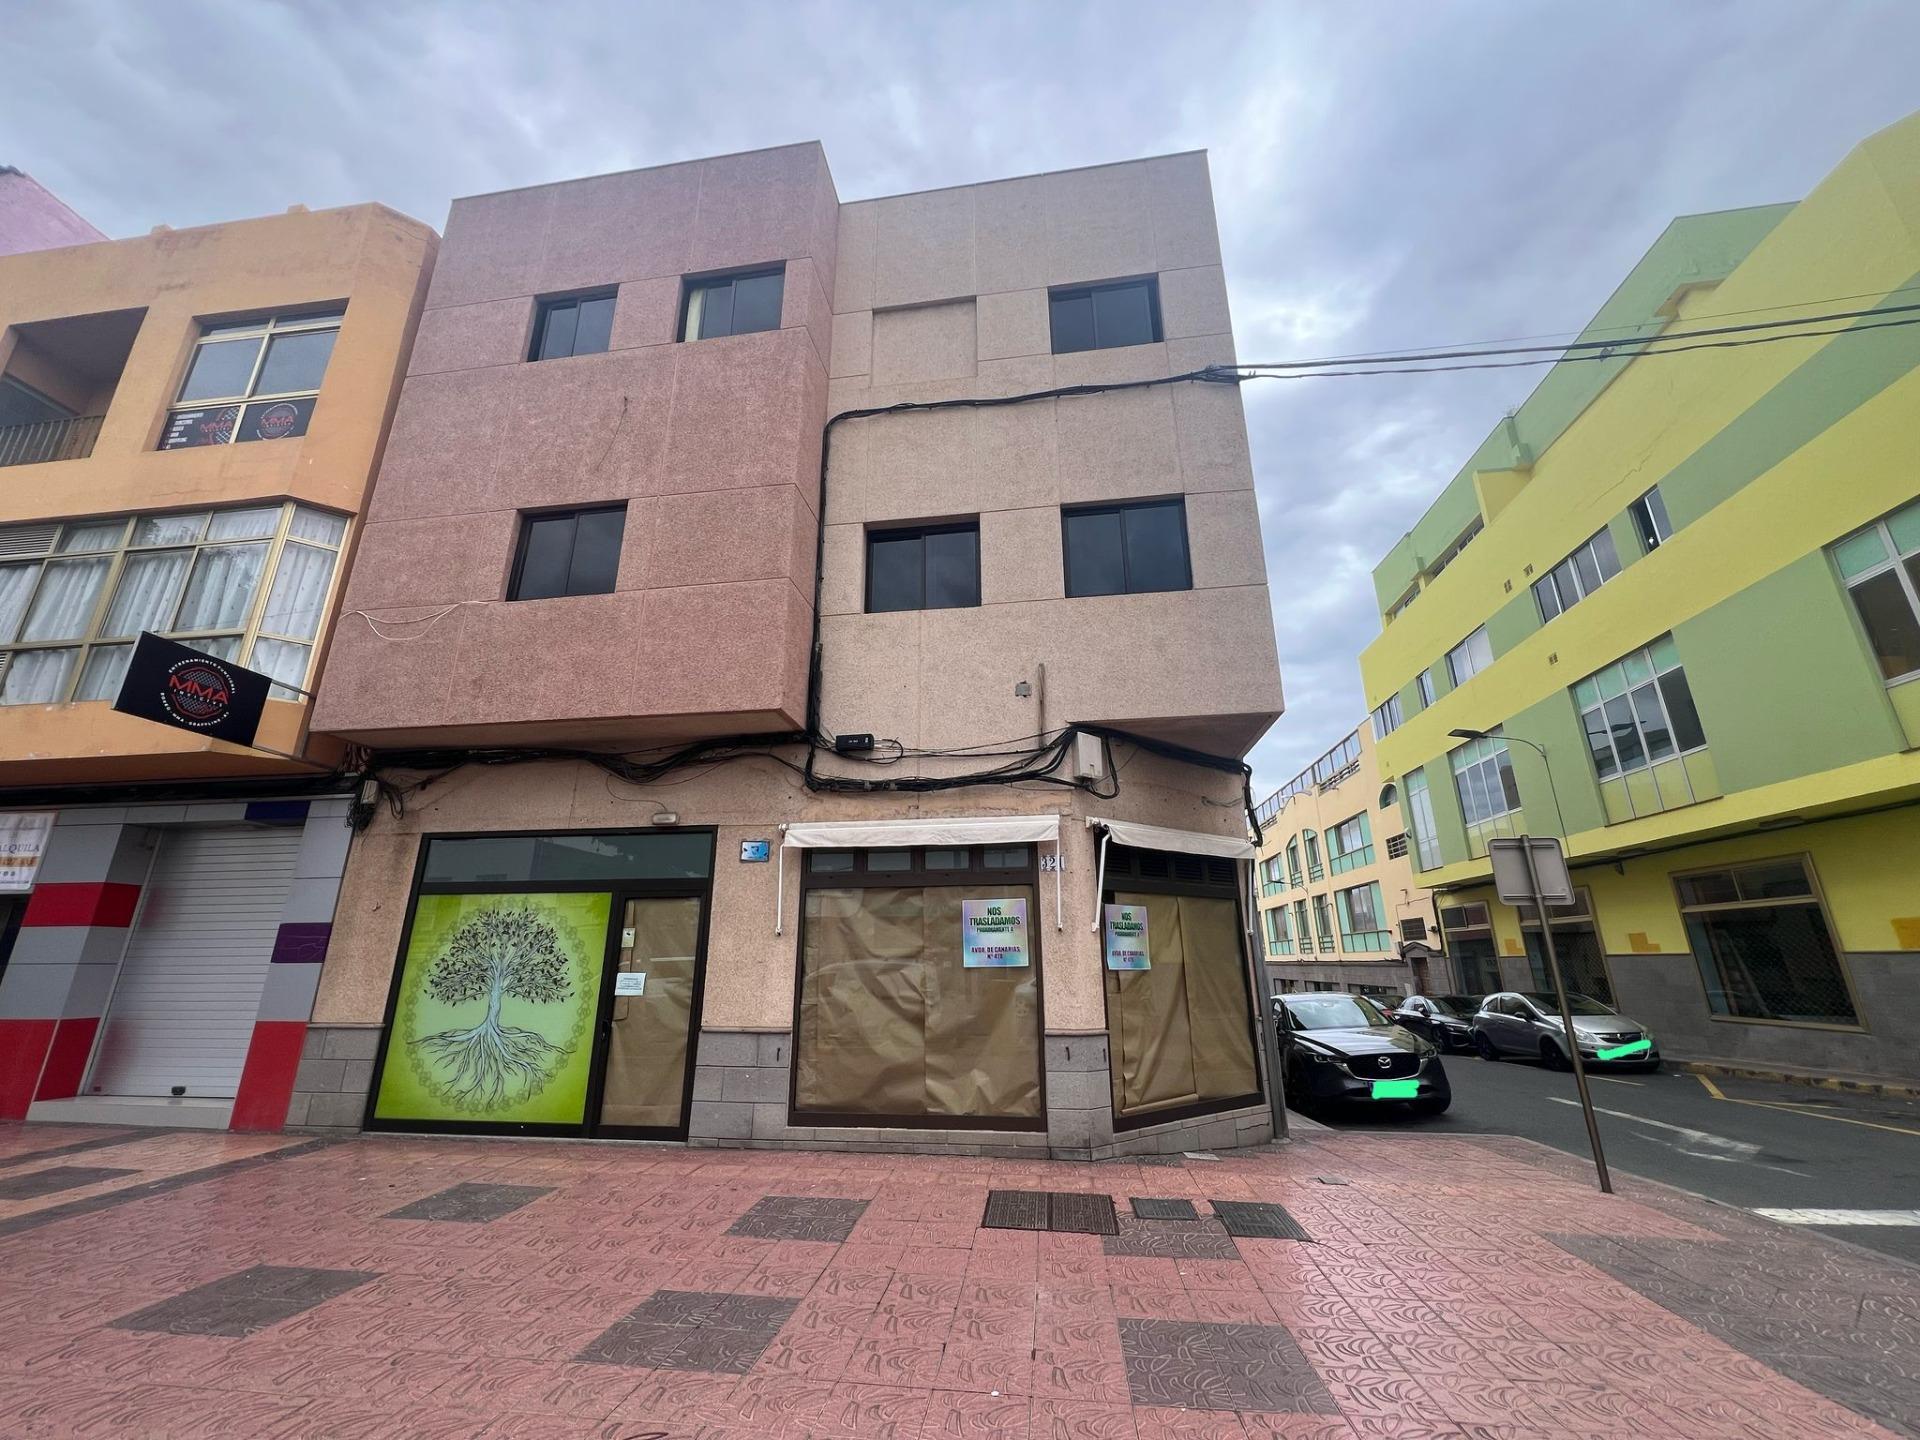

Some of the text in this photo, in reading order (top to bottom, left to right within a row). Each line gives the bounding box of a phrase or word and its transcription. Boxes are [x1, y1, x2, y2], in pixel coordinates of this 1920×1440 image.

[261, 415, 294, 427] MMA
[200, 420, 233, 433] MMA
[169, 674, 229, 705] MMA
[0, 844, 39, 854] LQUILA
[987, 906, 1002, 916] NOS
[969, 916, 1021, 926] TRASLADAMOS
[1121, 912, 1132, 921] NOS
[1110, 921, 1144, 931] TRASLADAMOS
